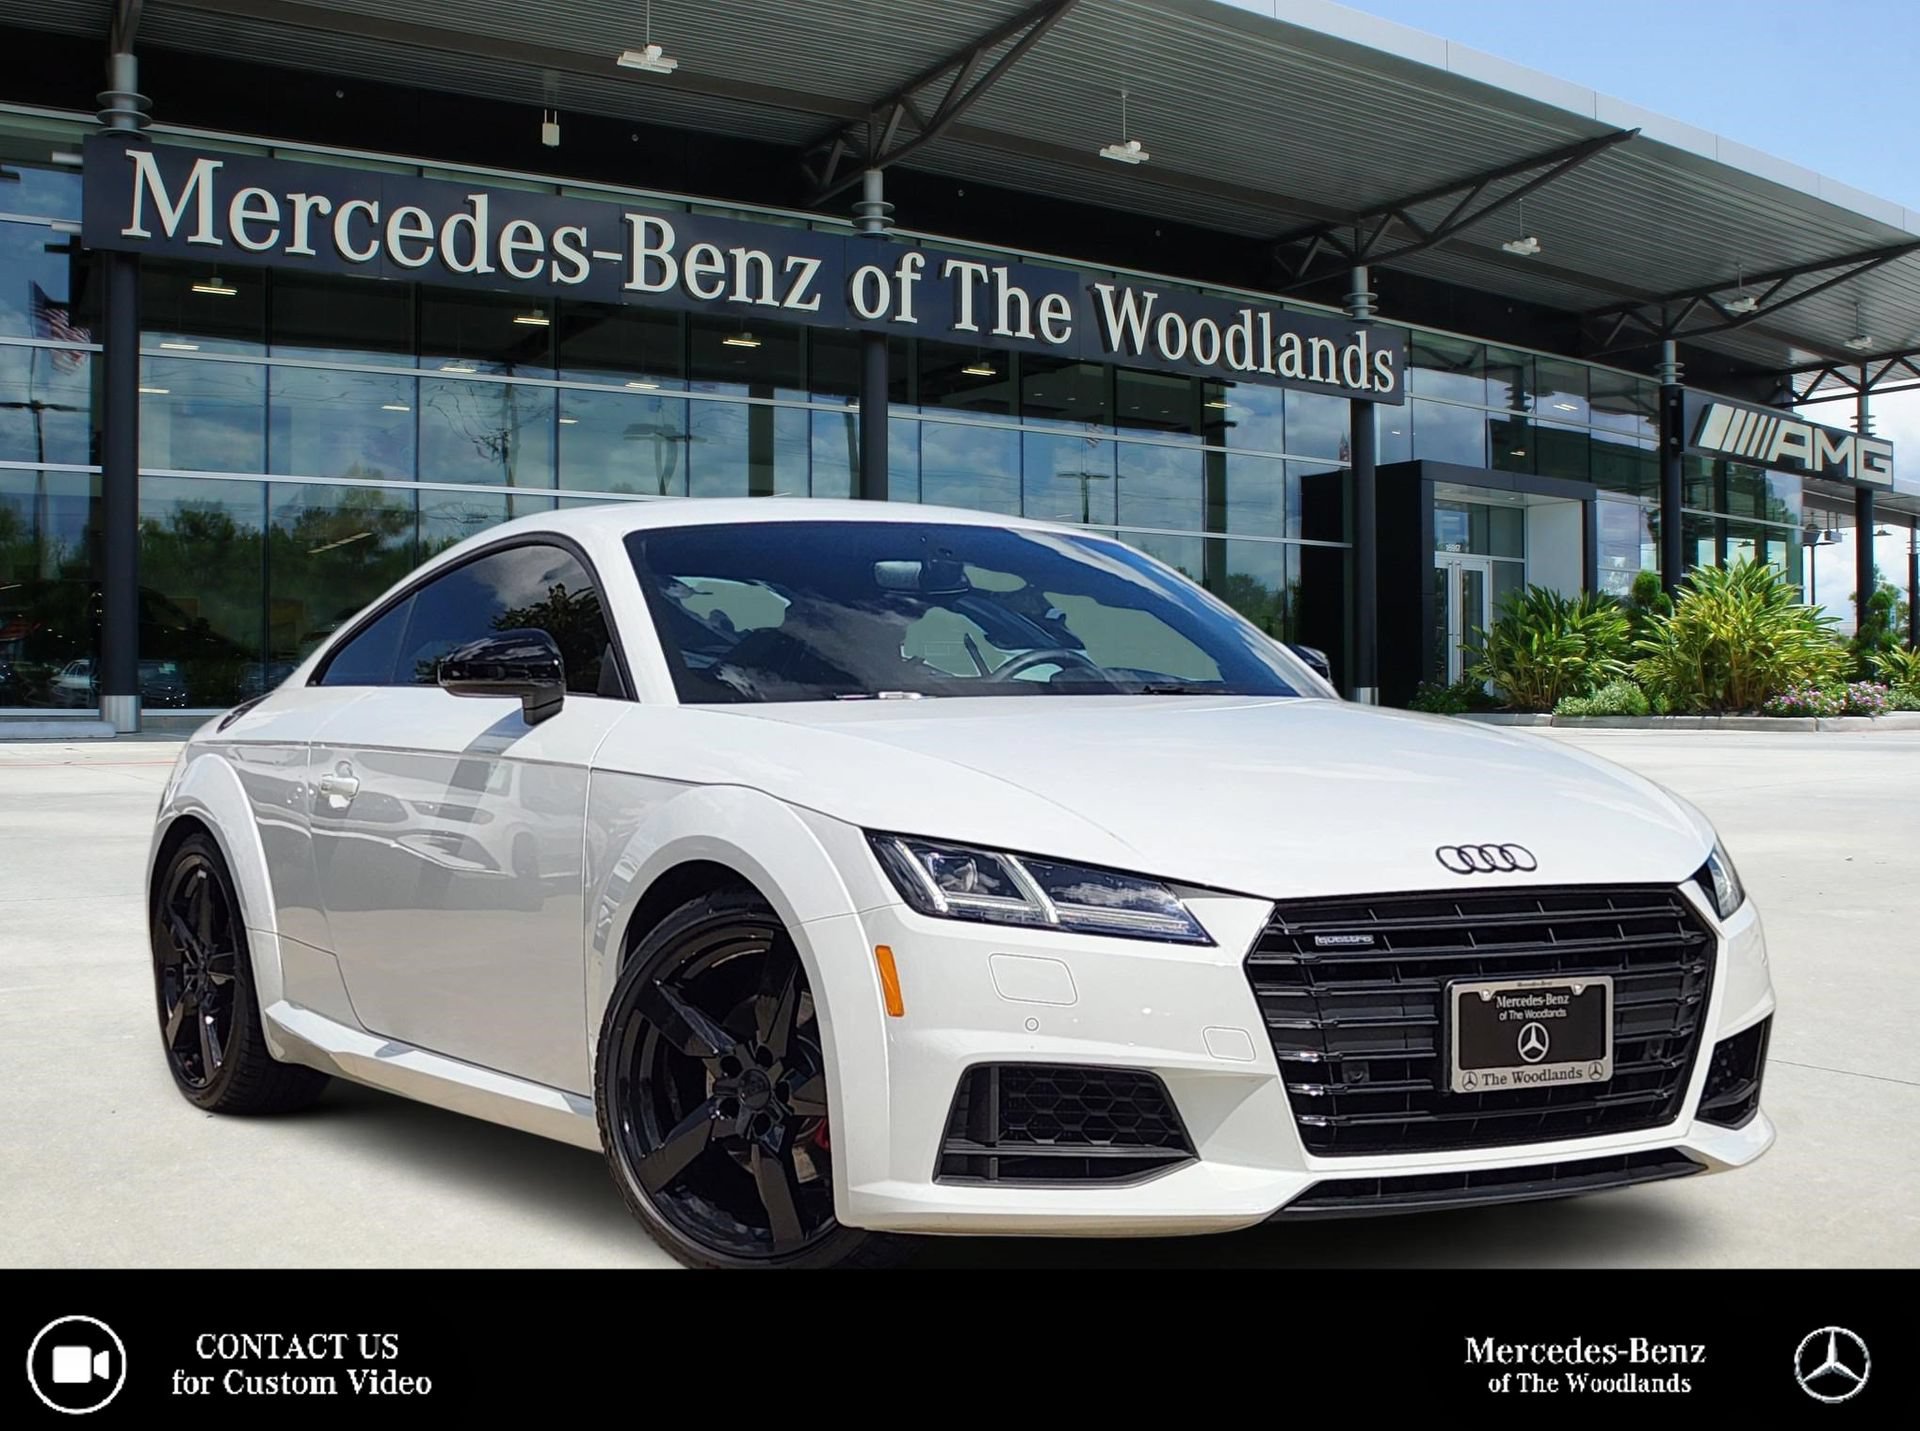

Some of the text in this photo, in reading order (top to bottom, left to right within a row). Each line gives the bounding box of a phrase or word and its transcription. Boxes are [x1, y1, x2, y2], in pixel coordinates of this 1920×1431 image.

[121, 149, 1394, 393] Mercedes-Benz of The Woodlands
[1767, 419, 1892, 486] AMG
[1496, 993, 1570, 1009] Mercedes-Benz
[1509, 1009, 1524, 1021] The
[1524, 1007, 1567, 1019] Woodlands
[1482, 1067, 1583, 1086] The Woodlands
